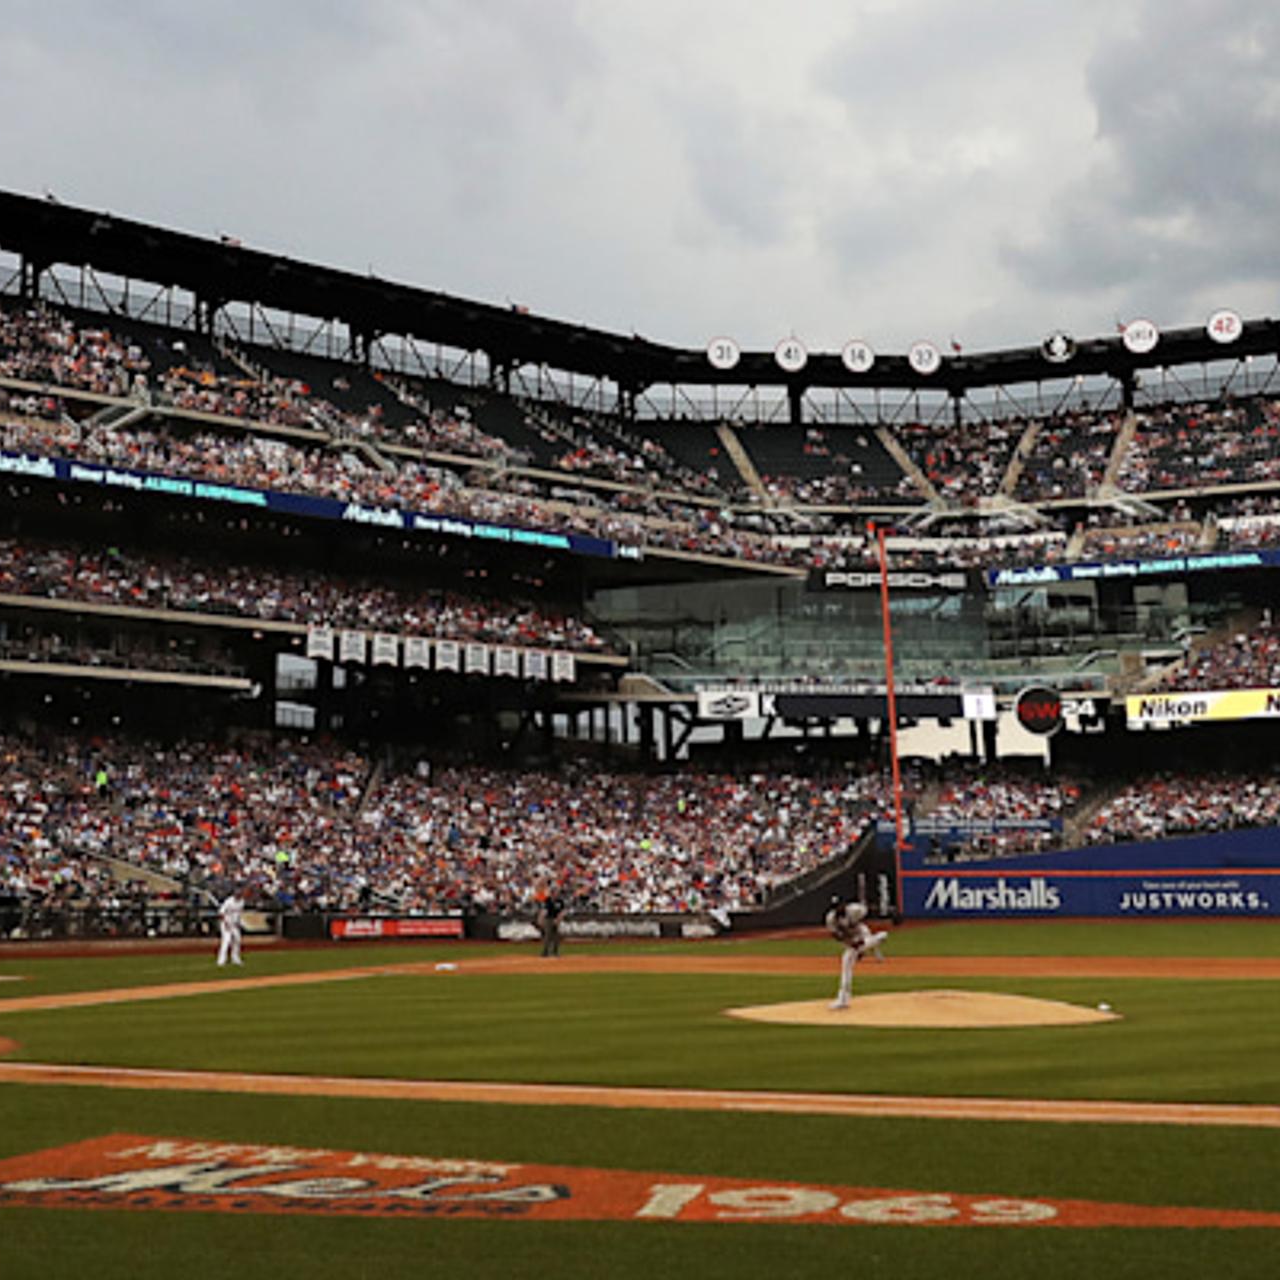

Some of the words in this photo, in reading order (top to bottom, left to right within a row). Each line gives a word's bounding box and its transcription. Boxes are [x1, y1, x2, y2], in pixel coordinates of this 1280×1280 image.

[1213, 316, 1235, 333] 42
[825, 571, 967, 589] PORSCHE
[995, 565, 1060, 585] Marshalls
[1138, 698, 1208, 719] Nikon
[924, 878, 1061, 911] Marshalls
[1119, 892, 1270, 909] JUSTWORKS.
[632, 1182, 1058, 1223] 1969
